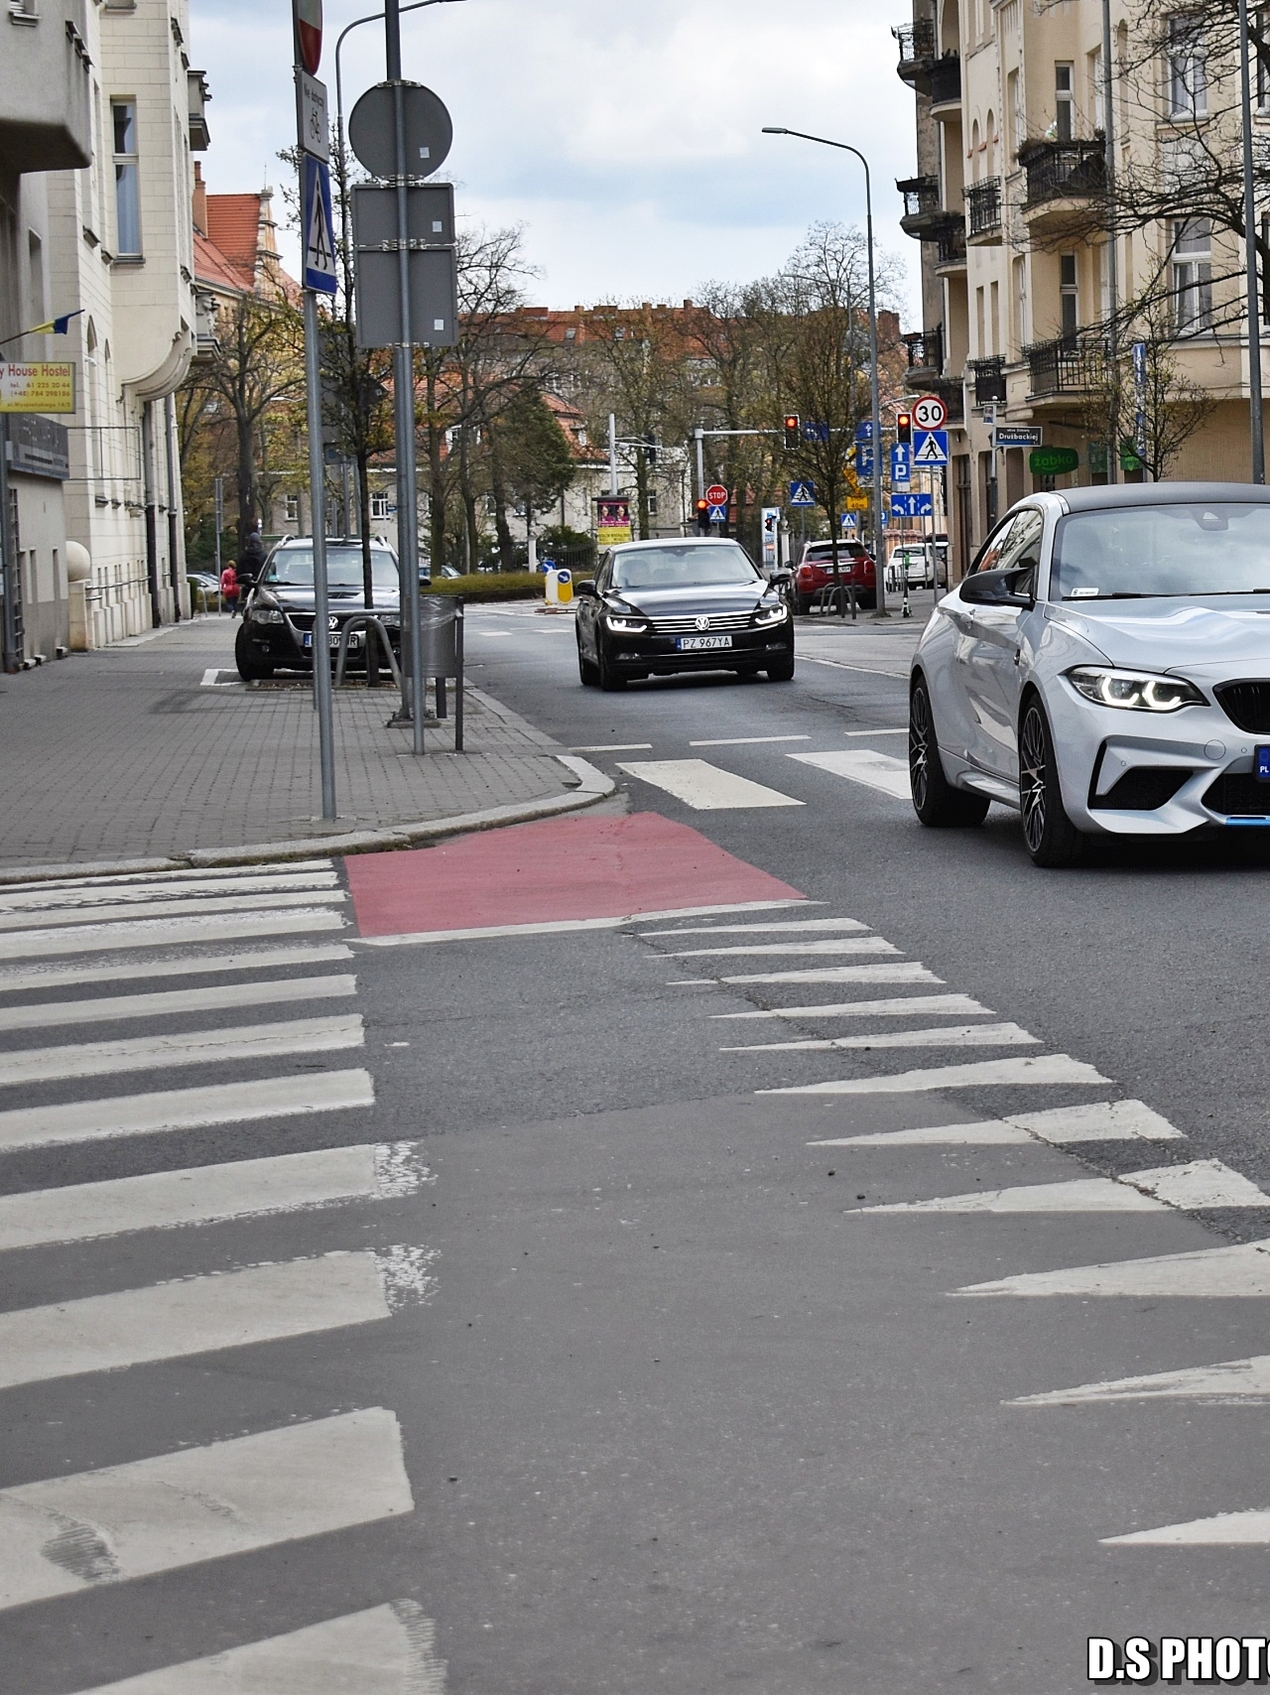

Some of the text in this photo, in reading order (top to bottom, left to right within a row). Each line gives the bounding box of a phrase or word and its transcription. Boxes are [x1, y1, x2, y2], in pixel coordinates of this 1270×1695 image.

[8, 364, 38, 376] House
[41, 364, 71, 376] Hostel
[918, 405, 942, 422] 30
[999, 433, 1039, 441] Drużbackiej
[1034, 455, 1074, 467] żabka
[895, 464, 907, 480] P
[709, 491, 726, 500] STOP
[683, 637, 730, 648] PZ 967YA
